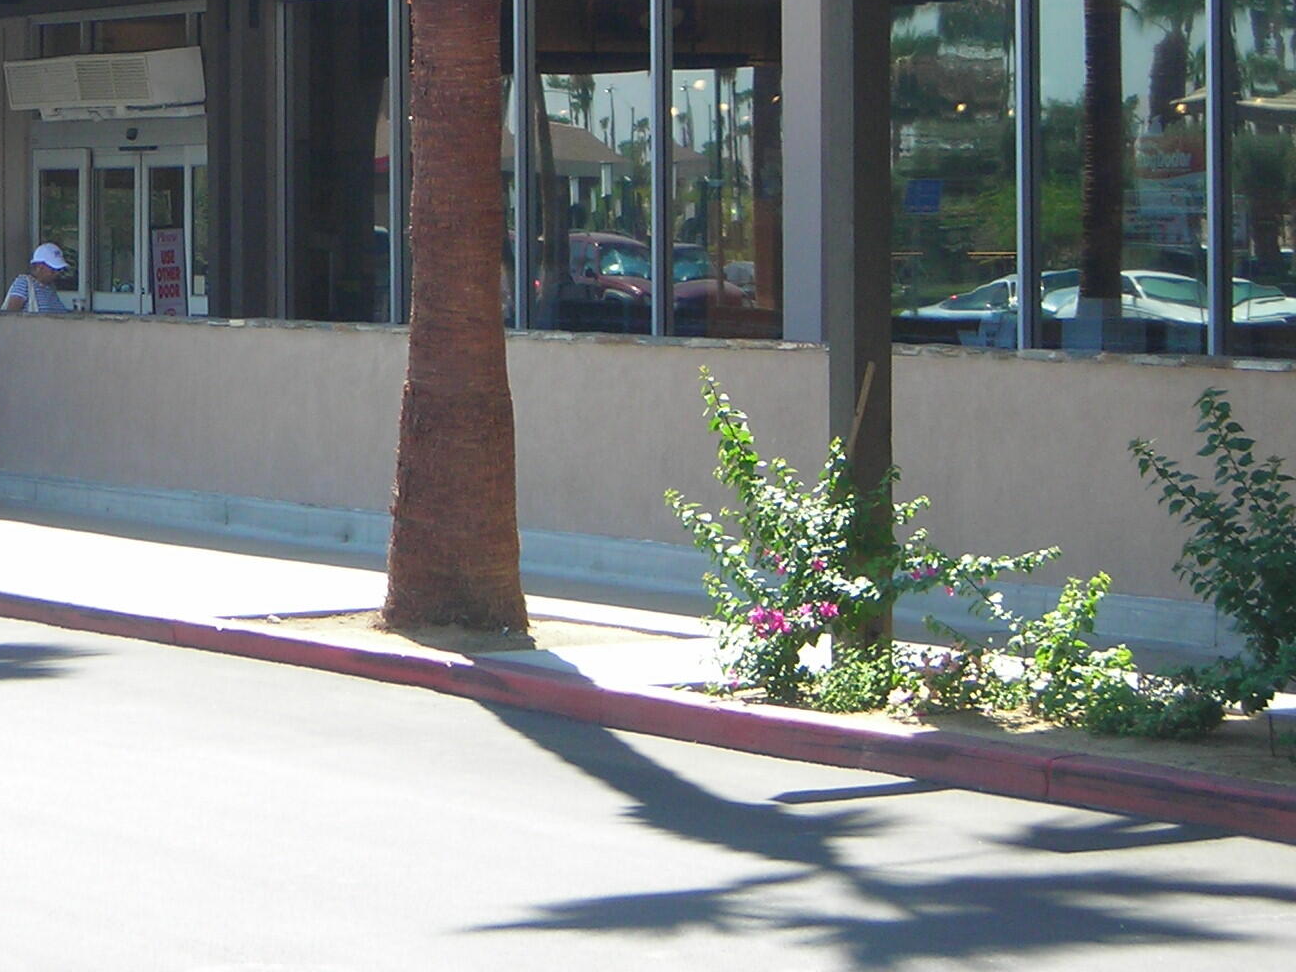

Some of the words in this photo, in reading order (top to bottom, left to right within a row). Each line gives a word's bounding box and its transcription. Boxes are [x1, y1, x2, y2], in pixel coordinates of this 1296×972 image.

[160, 250, 175, 265] USE
[157, 267, 181, 282] OTHER
[158, 284, 180, 299] DOOR
